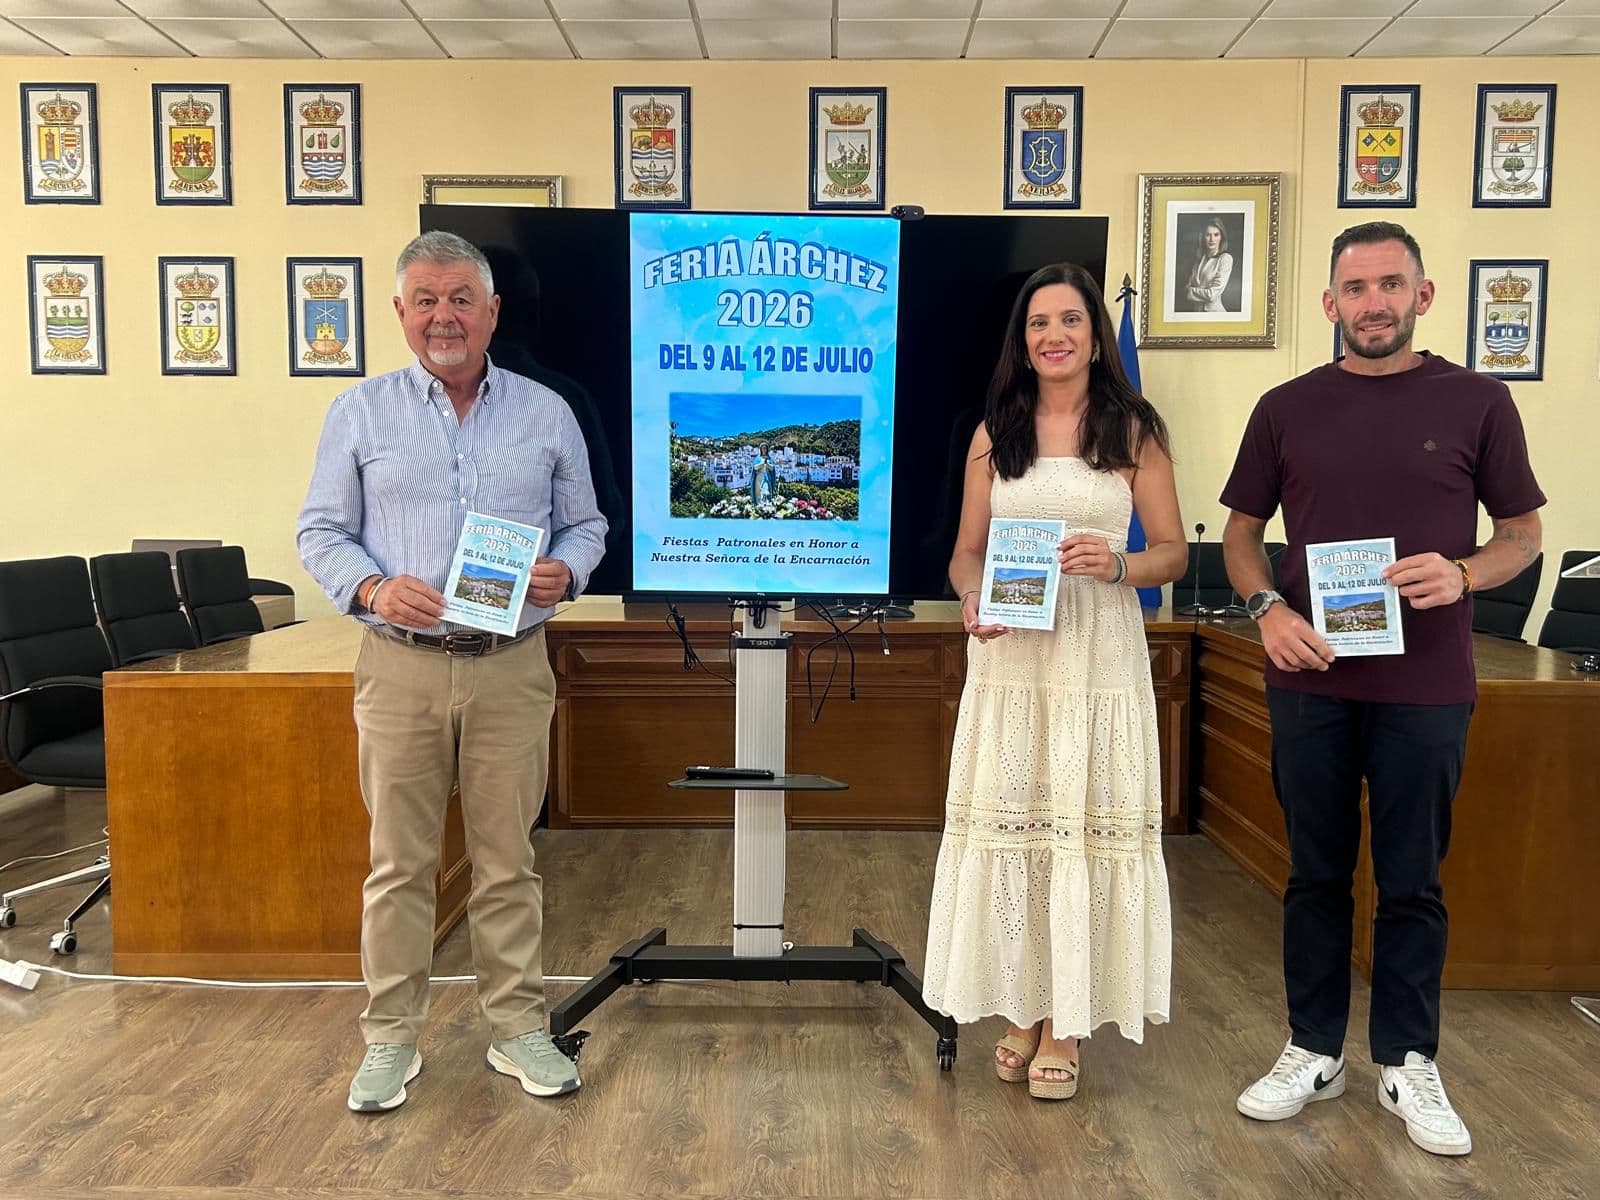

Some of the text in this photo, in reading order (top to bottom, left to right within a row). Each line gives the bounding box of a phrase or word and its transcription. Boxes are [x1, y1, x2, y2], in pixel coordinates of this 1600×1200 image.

[643, 230, 888, 294] FERIA ÁRCHEZ
[717, 288, 814, 328] 2026
[659, 343, 873, 373] DEL 9 AL 12 DE JULIO
[466, 525, 494, 535] FERIA
[992, 527, 1019, 540] FERIA
[483, 538, 511, 553] 2026
[662, 536, 709, 547] Fiestas
[716, 537, 786, 549] Patronales
[789, 541, 804, 549] en
[808, 538, 848, 549] Honor
[1011, 540, 1038, 551] 2026
[463, 548, 475, 558] DEL
[480, 553, 488, 561] AL
[489, 554, 497, 563] 12
[497, 556, 506, 565] DE
[506, 558, 524, 570] JULIO
[650, 553, 871, 566] Nuestra Señora de la Encarnación
[992, 554, 1053, 564] DEL 9 AL 12 DE JULIO
[1311, 552, 1341, 568] FERIA
[1335, 564, 1366, 576] 2026
[1318, 578, 1387, 590] DEL 9 AL 12 DE JULIO
